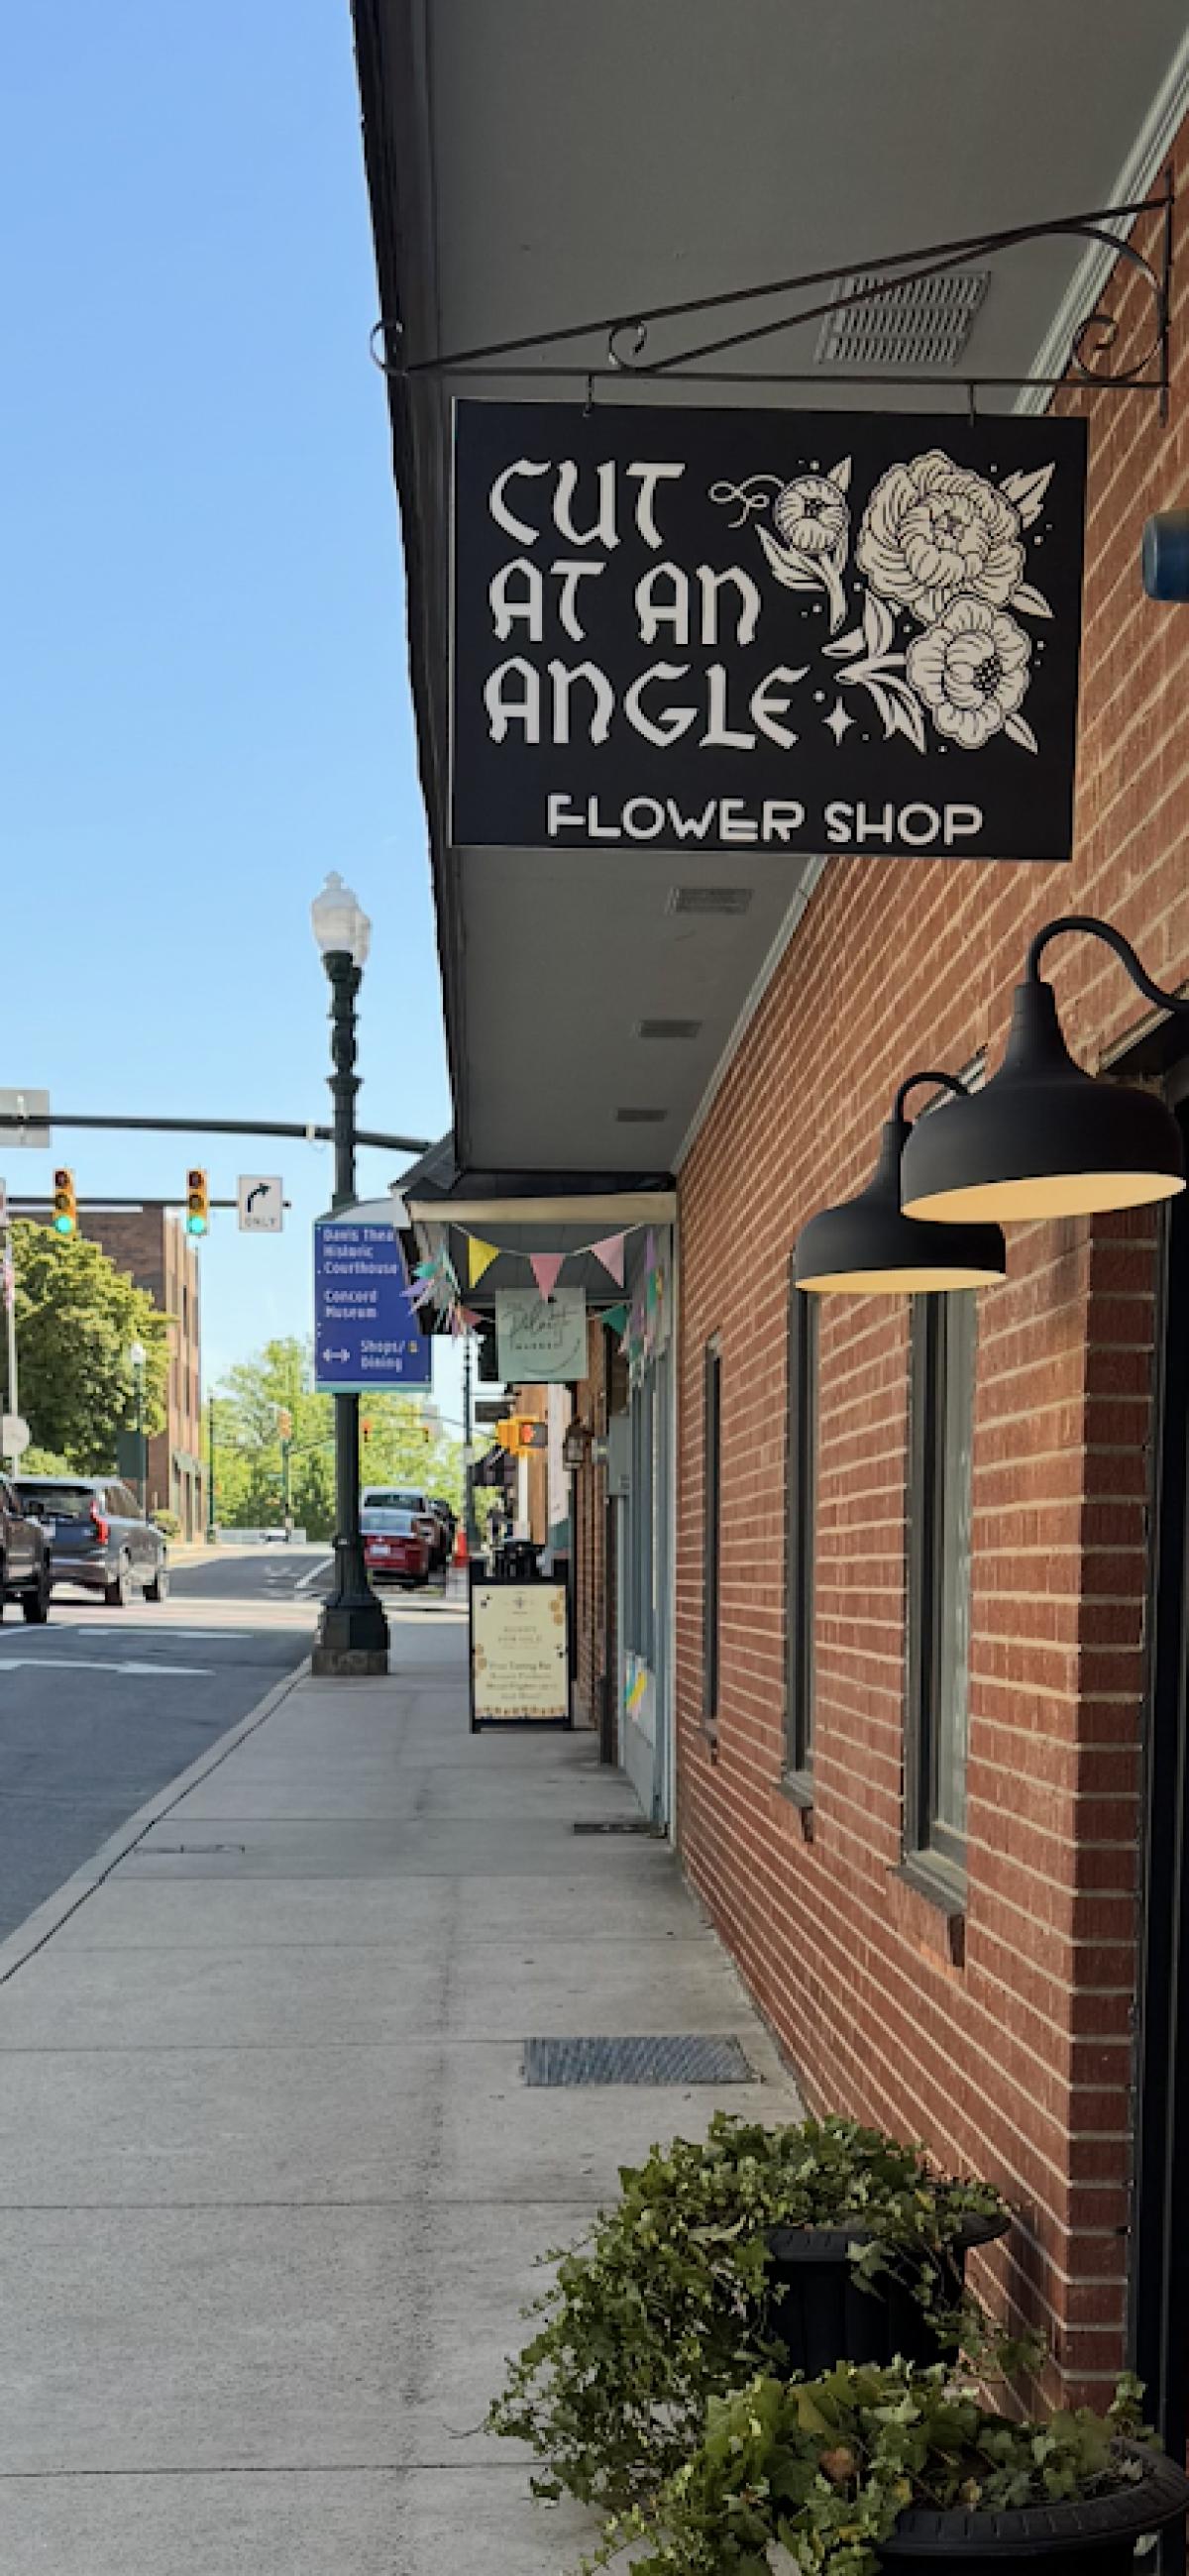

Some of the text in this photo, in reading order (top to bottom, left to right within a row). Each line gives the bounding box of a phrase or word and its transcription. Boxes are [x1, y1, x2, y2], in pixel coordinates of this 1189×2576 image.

[489, 459, 686, 550] CUT
[489, 558, 762, 645] AT AN
[484, 656, 811, 750] ANGLE
[547, 794, 984, 846] FLOWER SHOP
[245, 1217, 277, 1228] ONLY
[323, 1229, 360, 1242] Davis
[323, 1244, 375, 1258] Historic
[323, 1261, 398, 1274] Courthouse
[323, 1290, 378, 1304] Concord
[325, 1306, 378, 1319] Museum
[361, 1356, 403, 1372] Dining
